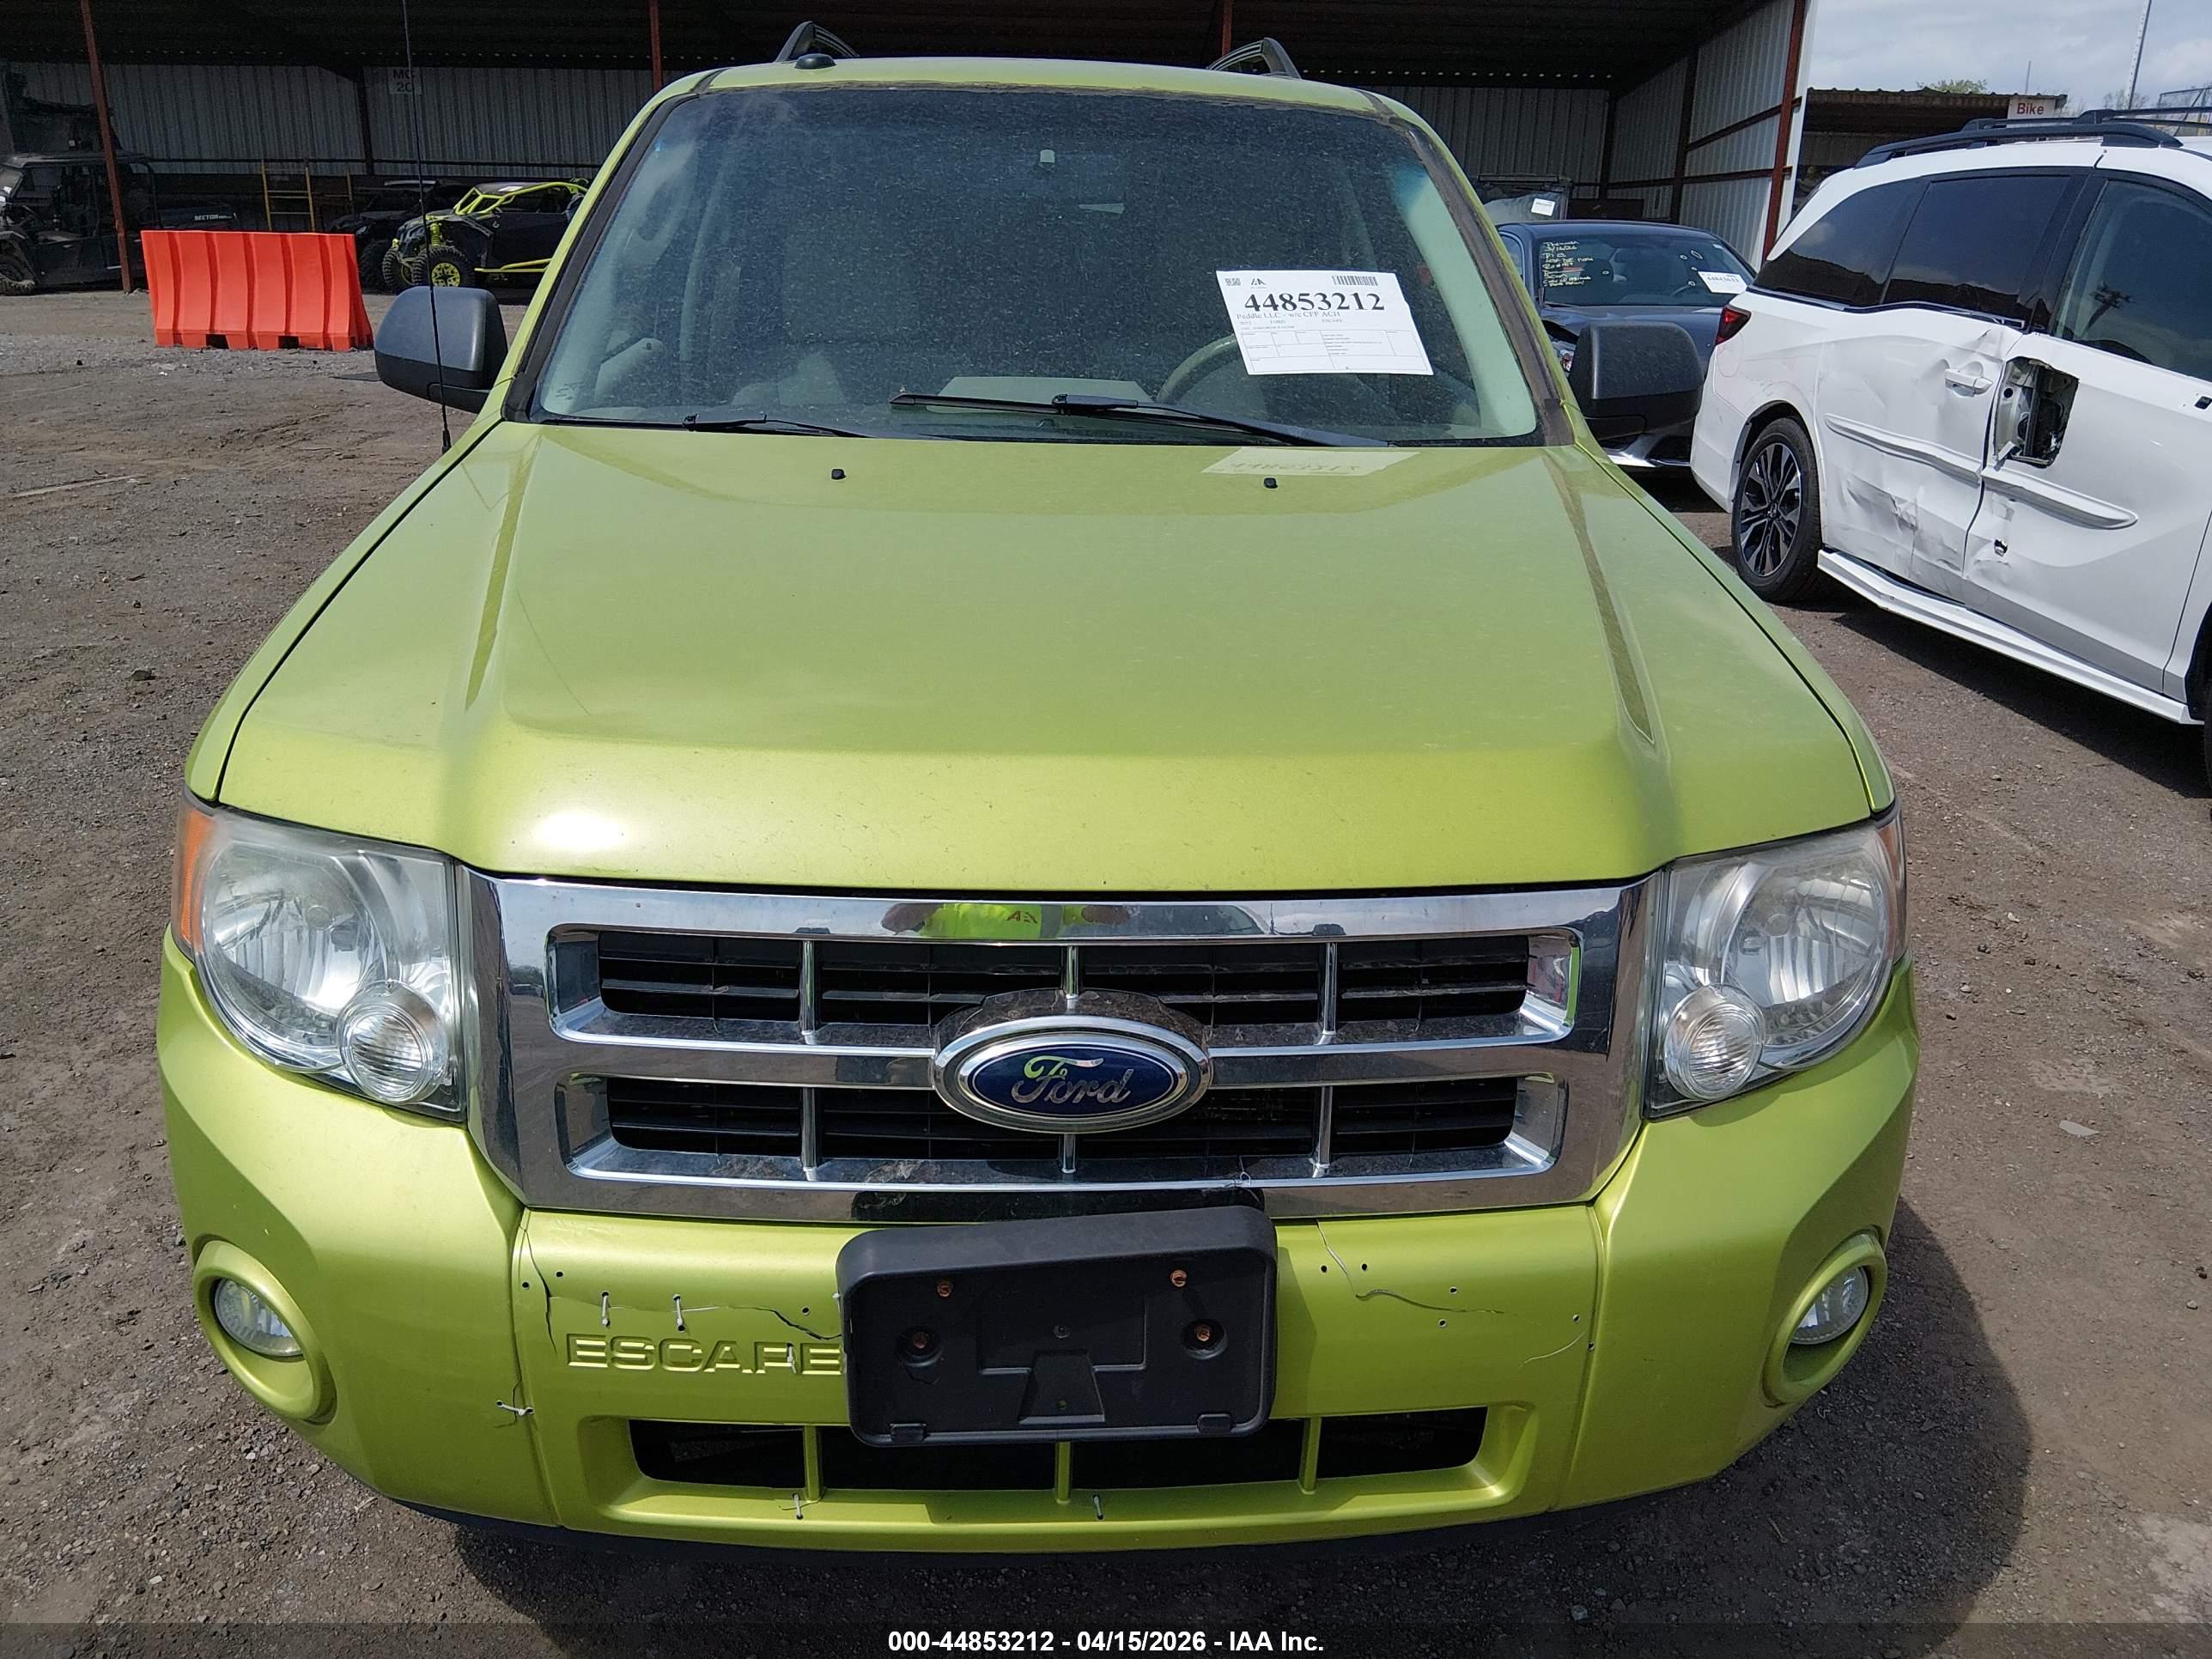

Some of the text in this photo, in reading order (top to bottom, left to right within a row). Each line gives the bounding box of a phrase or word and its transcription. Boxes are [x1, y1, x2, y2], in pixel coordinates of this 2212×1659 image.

[2016, 102, 2045, 114] Bike
[1244, 292, 1384, 312] 44853212
[1012, 1055, 1134, 1104] Ford
[567, 1334, 842, 1376] ESCAPE
